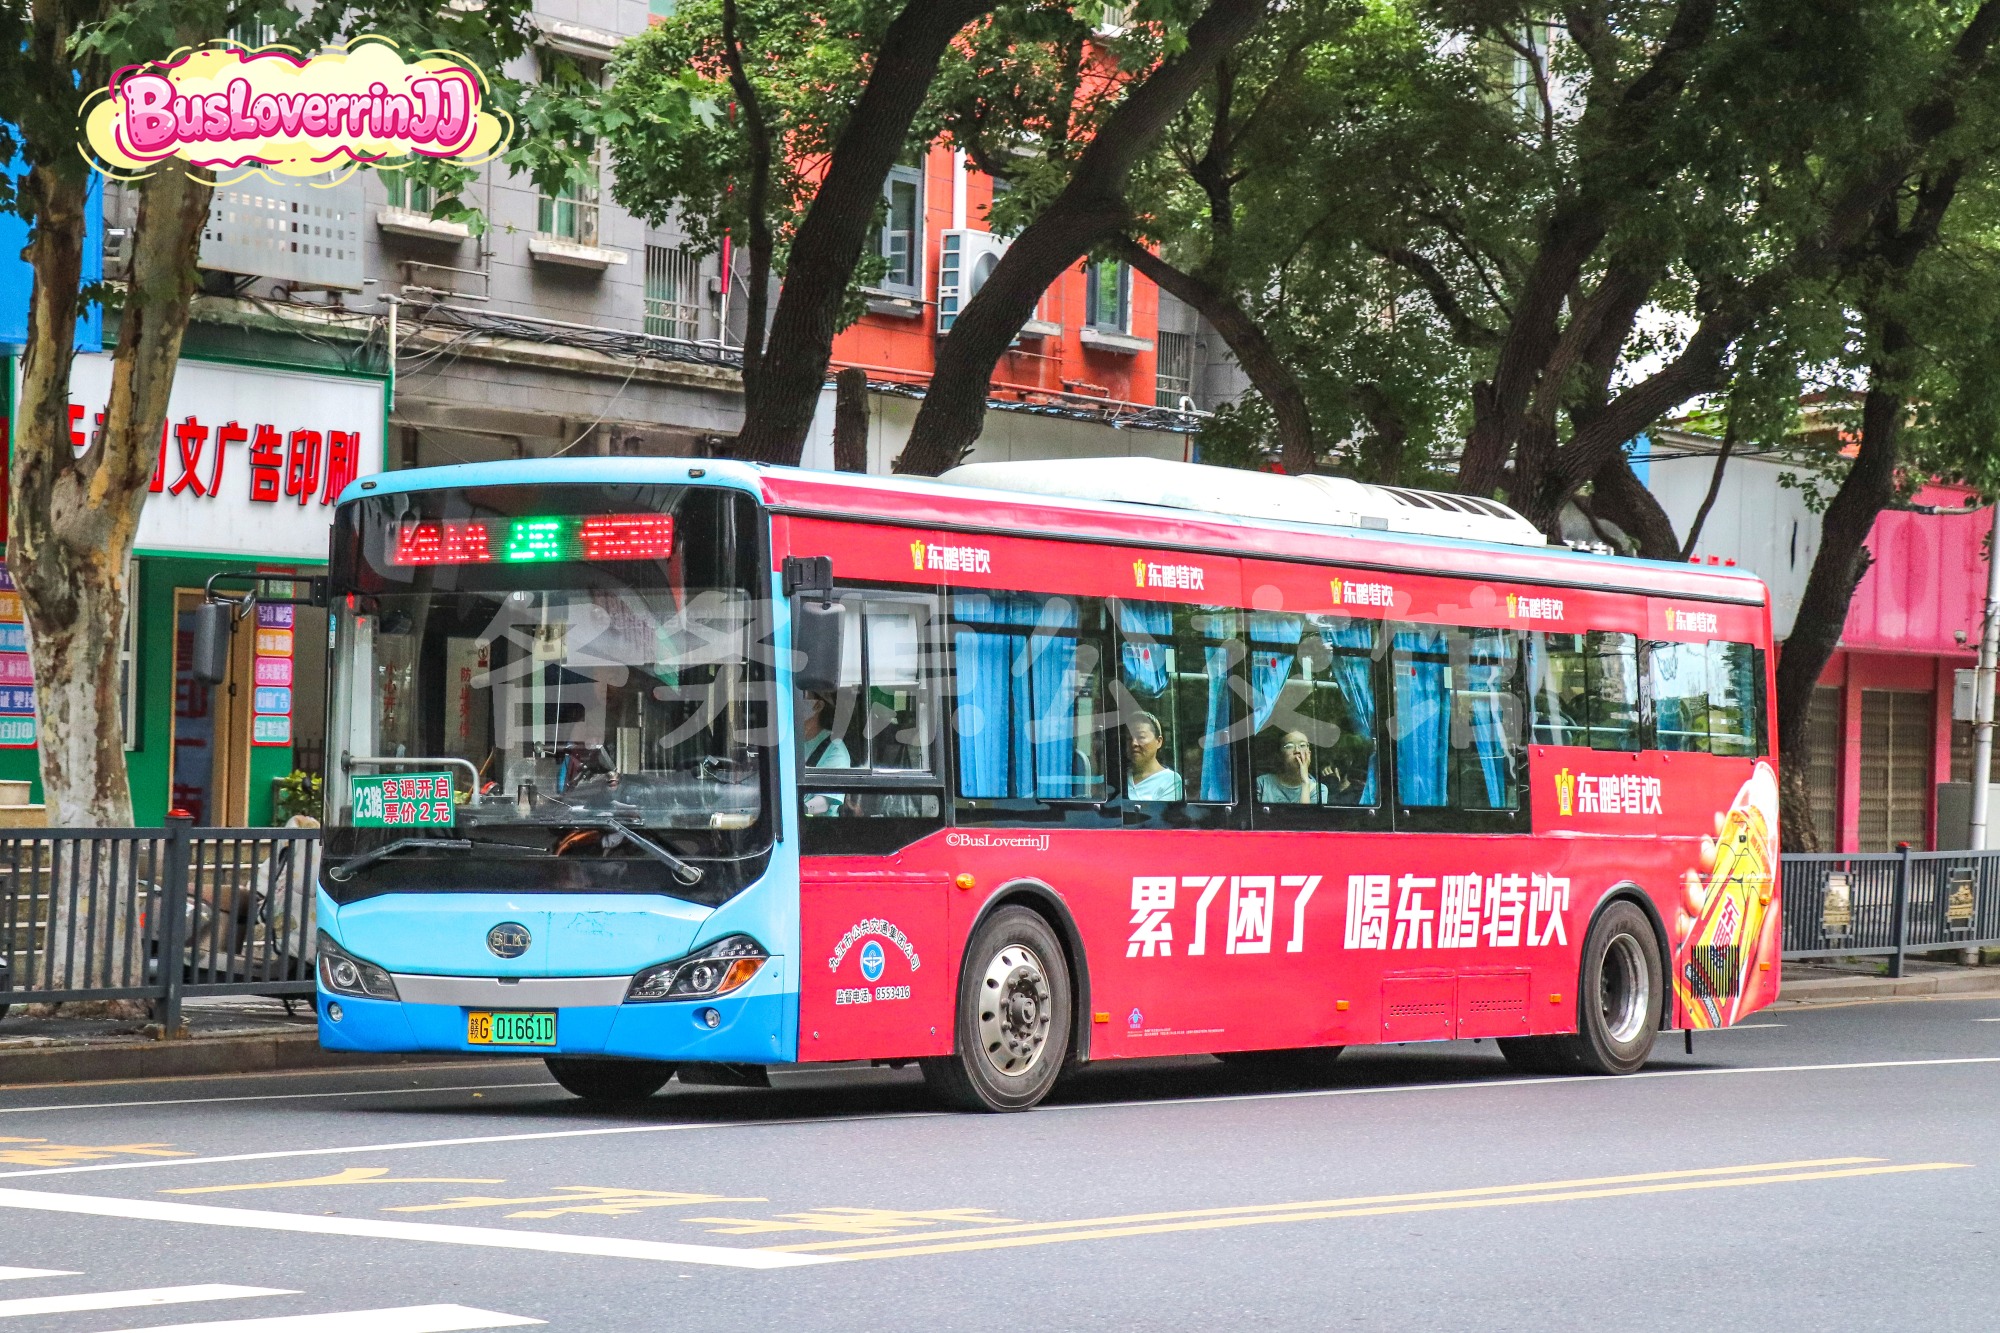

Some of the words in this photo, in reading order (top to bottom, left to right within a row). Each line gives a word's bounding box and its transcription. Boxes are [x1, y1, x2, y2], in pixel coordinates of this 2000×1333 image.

[68, 403, 361, 506] 文广告印刷
[927, 543, 991, 574] 东鹏特饮
[1148, 561, 1205, 591] 东鹏特饮
[1342, 580, 1394, 607] 东鹏特饮
[1517, 595, 1564, 621] 东鹏特饮
[1675, 611, 1717, 634] 东鹏特饮
[355, 785, 383, 819] 23路
[383, 778, 450, 800] 空调开启
[1576, 772, 1663, 815] 东鹏特饮
[384, 802, 451, 824] 票价2元
[1125, 875, 1323, 959] 累了困了
[1343, 871, 1571, 951] 喝东鹏特饮
[829, 918, 921, 973] 九江市公共交通集团公司
